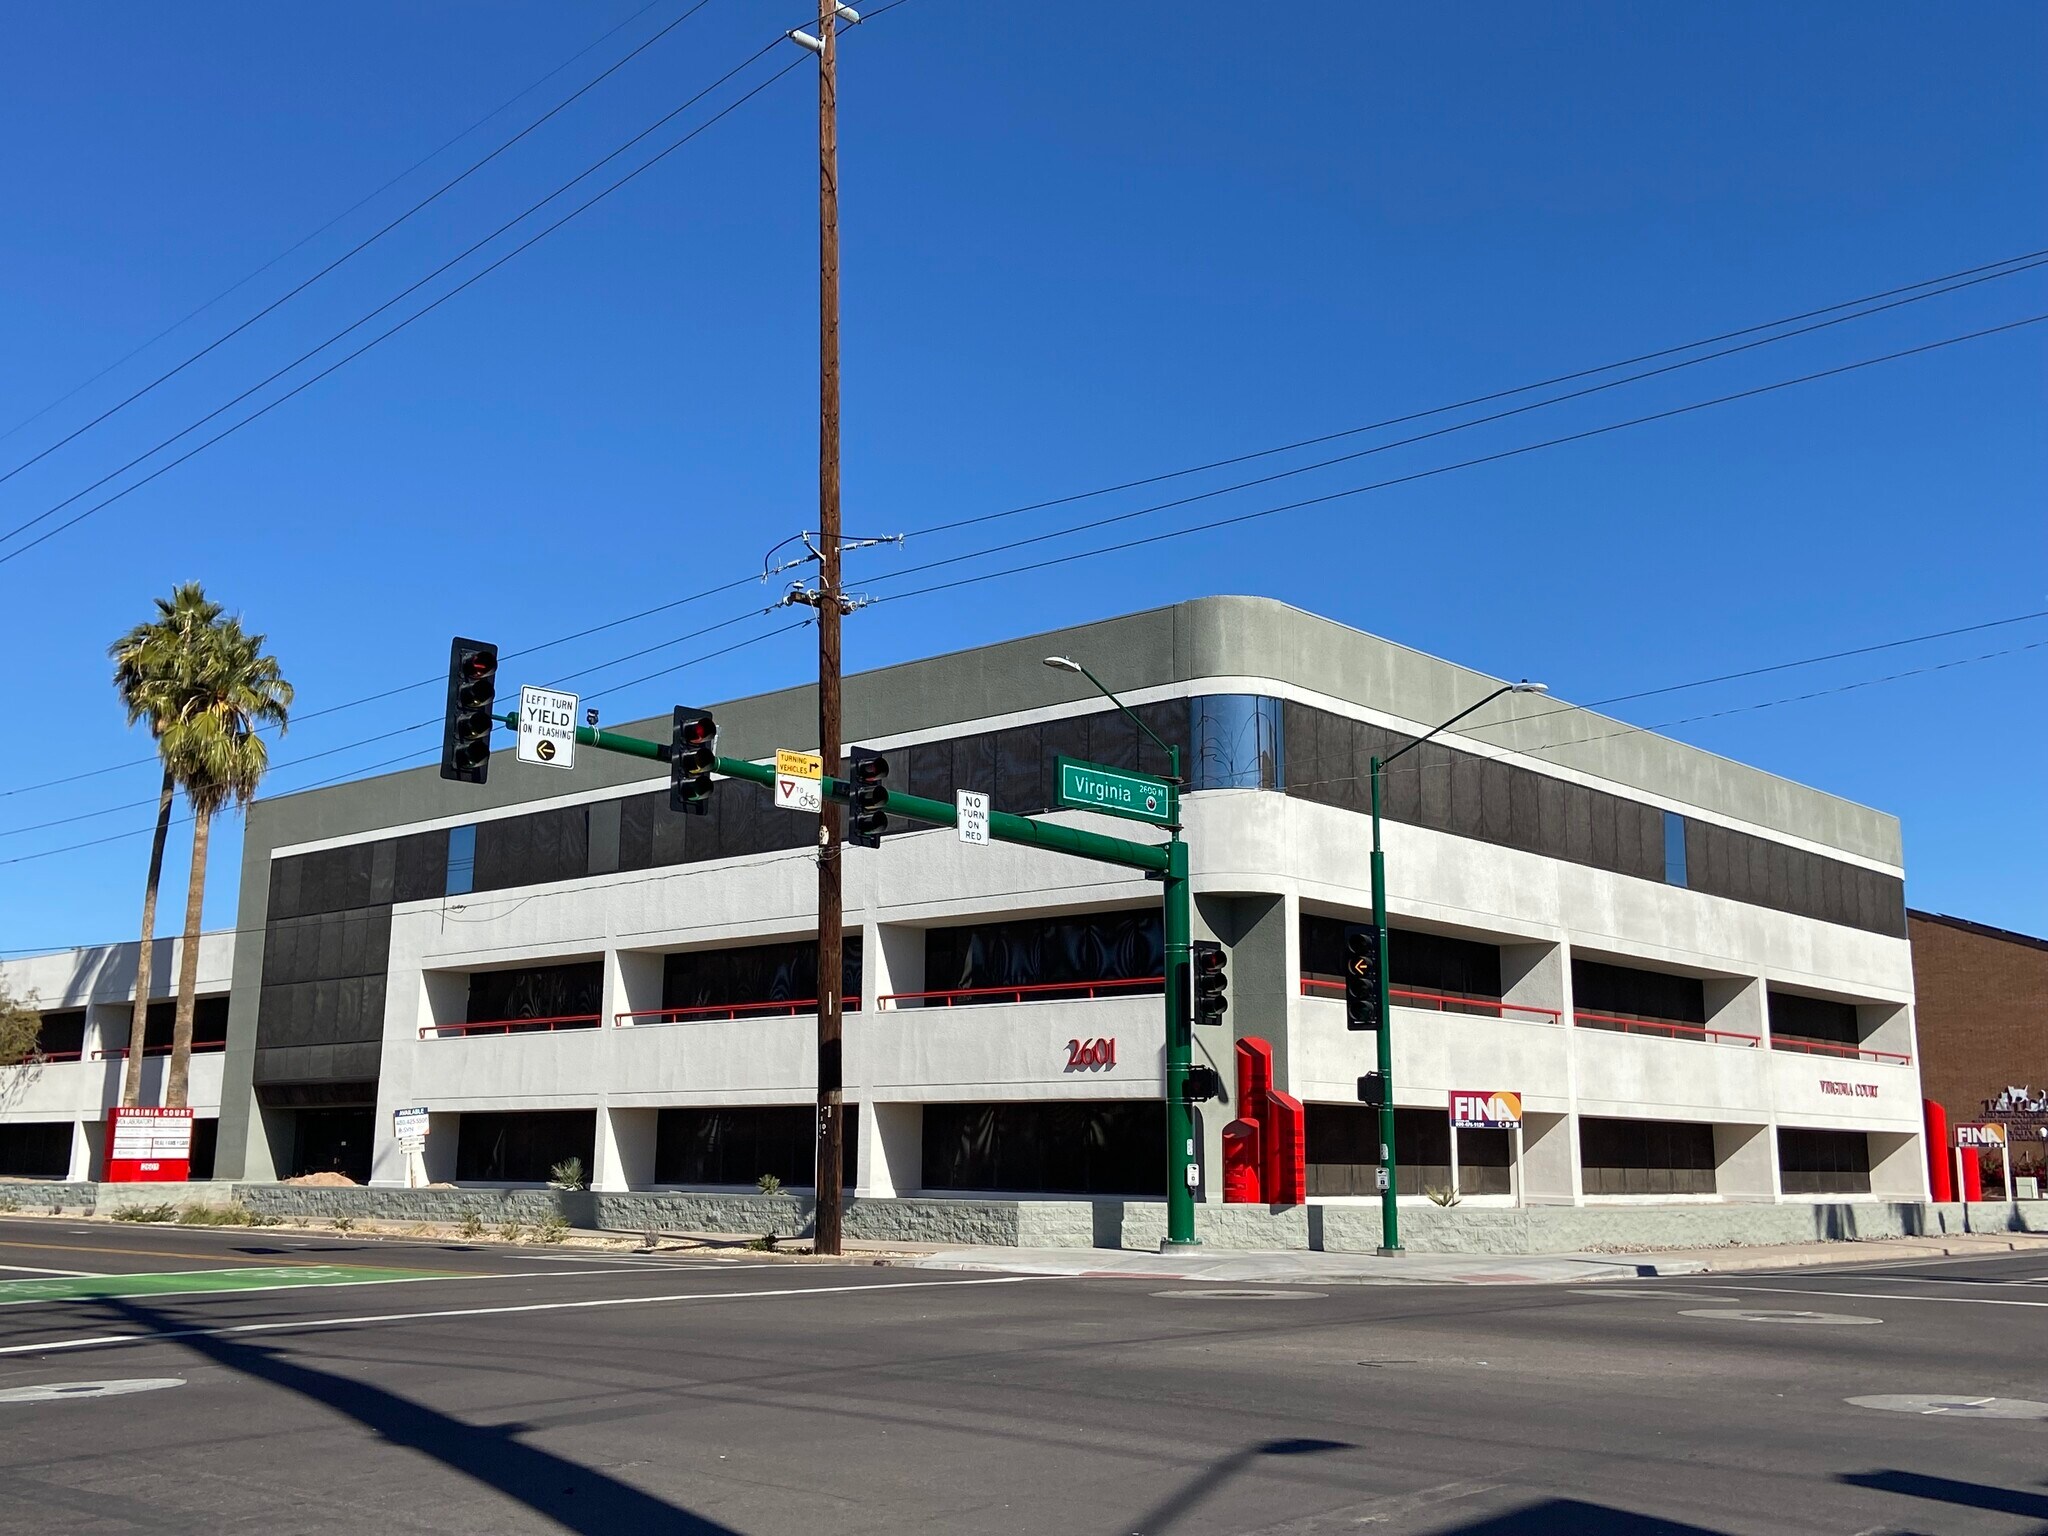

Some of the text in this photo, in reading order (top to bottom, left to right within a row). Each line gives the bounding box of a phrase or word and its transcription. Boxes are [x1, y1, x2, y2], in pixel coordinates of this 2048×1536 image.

[526, 693, 573, 711] LEFT TURN
[528, 707, 570, 727] YIELD
[523, 723, 571, 740] ON FLASHING
[780, 754, 807, 765] TURNING
[779, 763, 808, 775] VEHICLES
[796, 786, 804, 794] TO
[1075, 775, 1164, 802] Virginia 2600 N
[965, 796, 981, 808] NO
[963, 808, 985, 820] TURN
[967, 820, 980, 830] ON
[965, 830, 982, 841] RED
[1065, 1038, 1116, 1068] 2601
[1819, 1080, 1879, 1098] VIRGINIA COURT
[120, 1108, 191, 1117] VIRGINIA COURT
[399, 1108, 425, 1117] AVAILABLE
[1455, 1096, 1517, 1121] FINA
[1957, 1127, 2002, 1143] FINA
